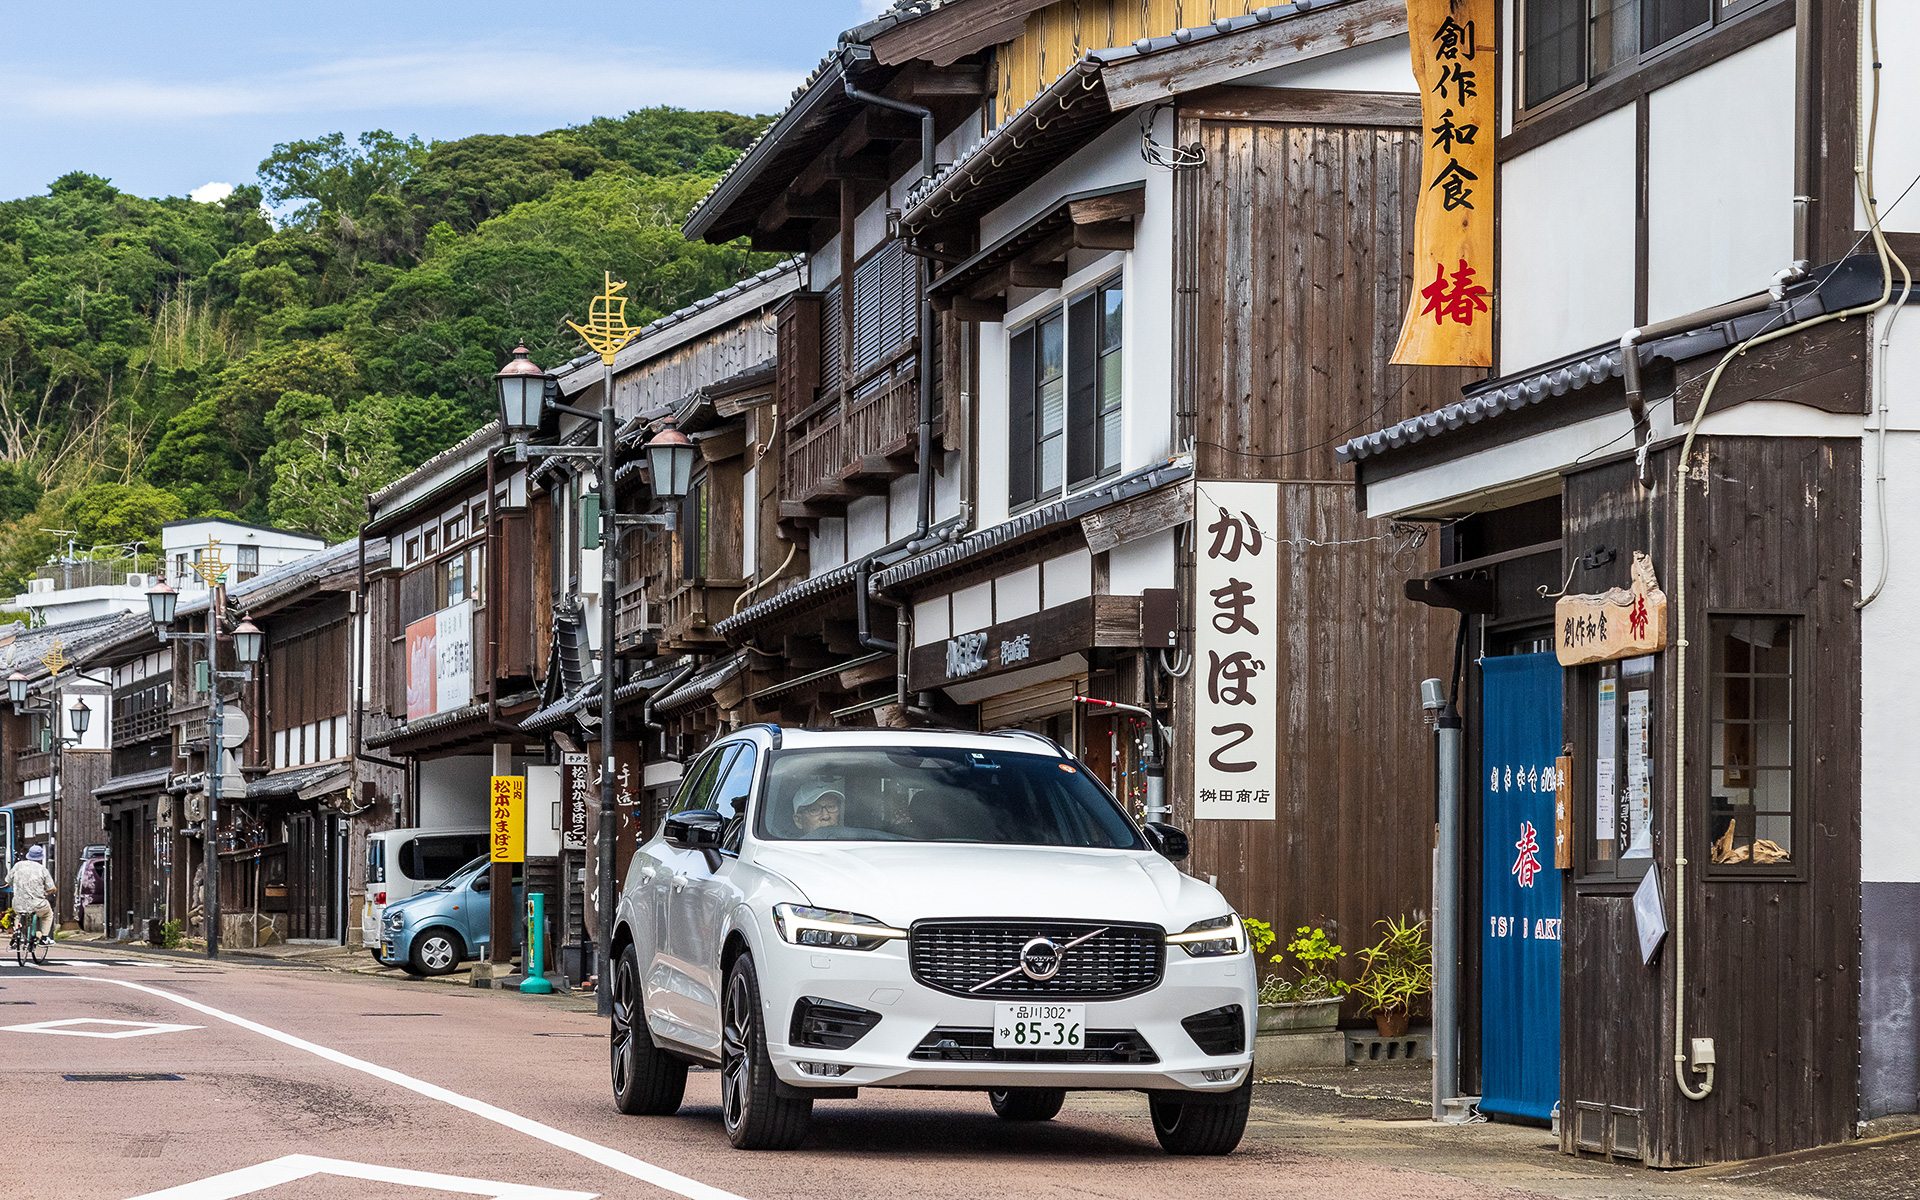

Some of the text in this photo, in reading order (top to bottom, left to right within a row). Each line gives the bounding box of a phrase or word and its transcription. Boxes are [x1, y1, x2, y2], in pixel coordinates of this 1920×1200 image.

[1421, 16, 1488, 326] 創作和食 椿
[1207, 506, 1266, 773] かまぼこ
[1564, 593, 1649, 648] 創作和食 椿
[494, 779, 511, 860] 松本かまぼこ
[513, 780, 523, 801] 川内
[572, 765, 587, 835] 松本かまぼこ
[1199, 787, 1271, 804] 桝田商店
[1556, 768, 1566, 853] 準備中
[1512, 820, 1541, 888] 椿
[1000, 1022, 1080, 1045] ゆ 85-36
